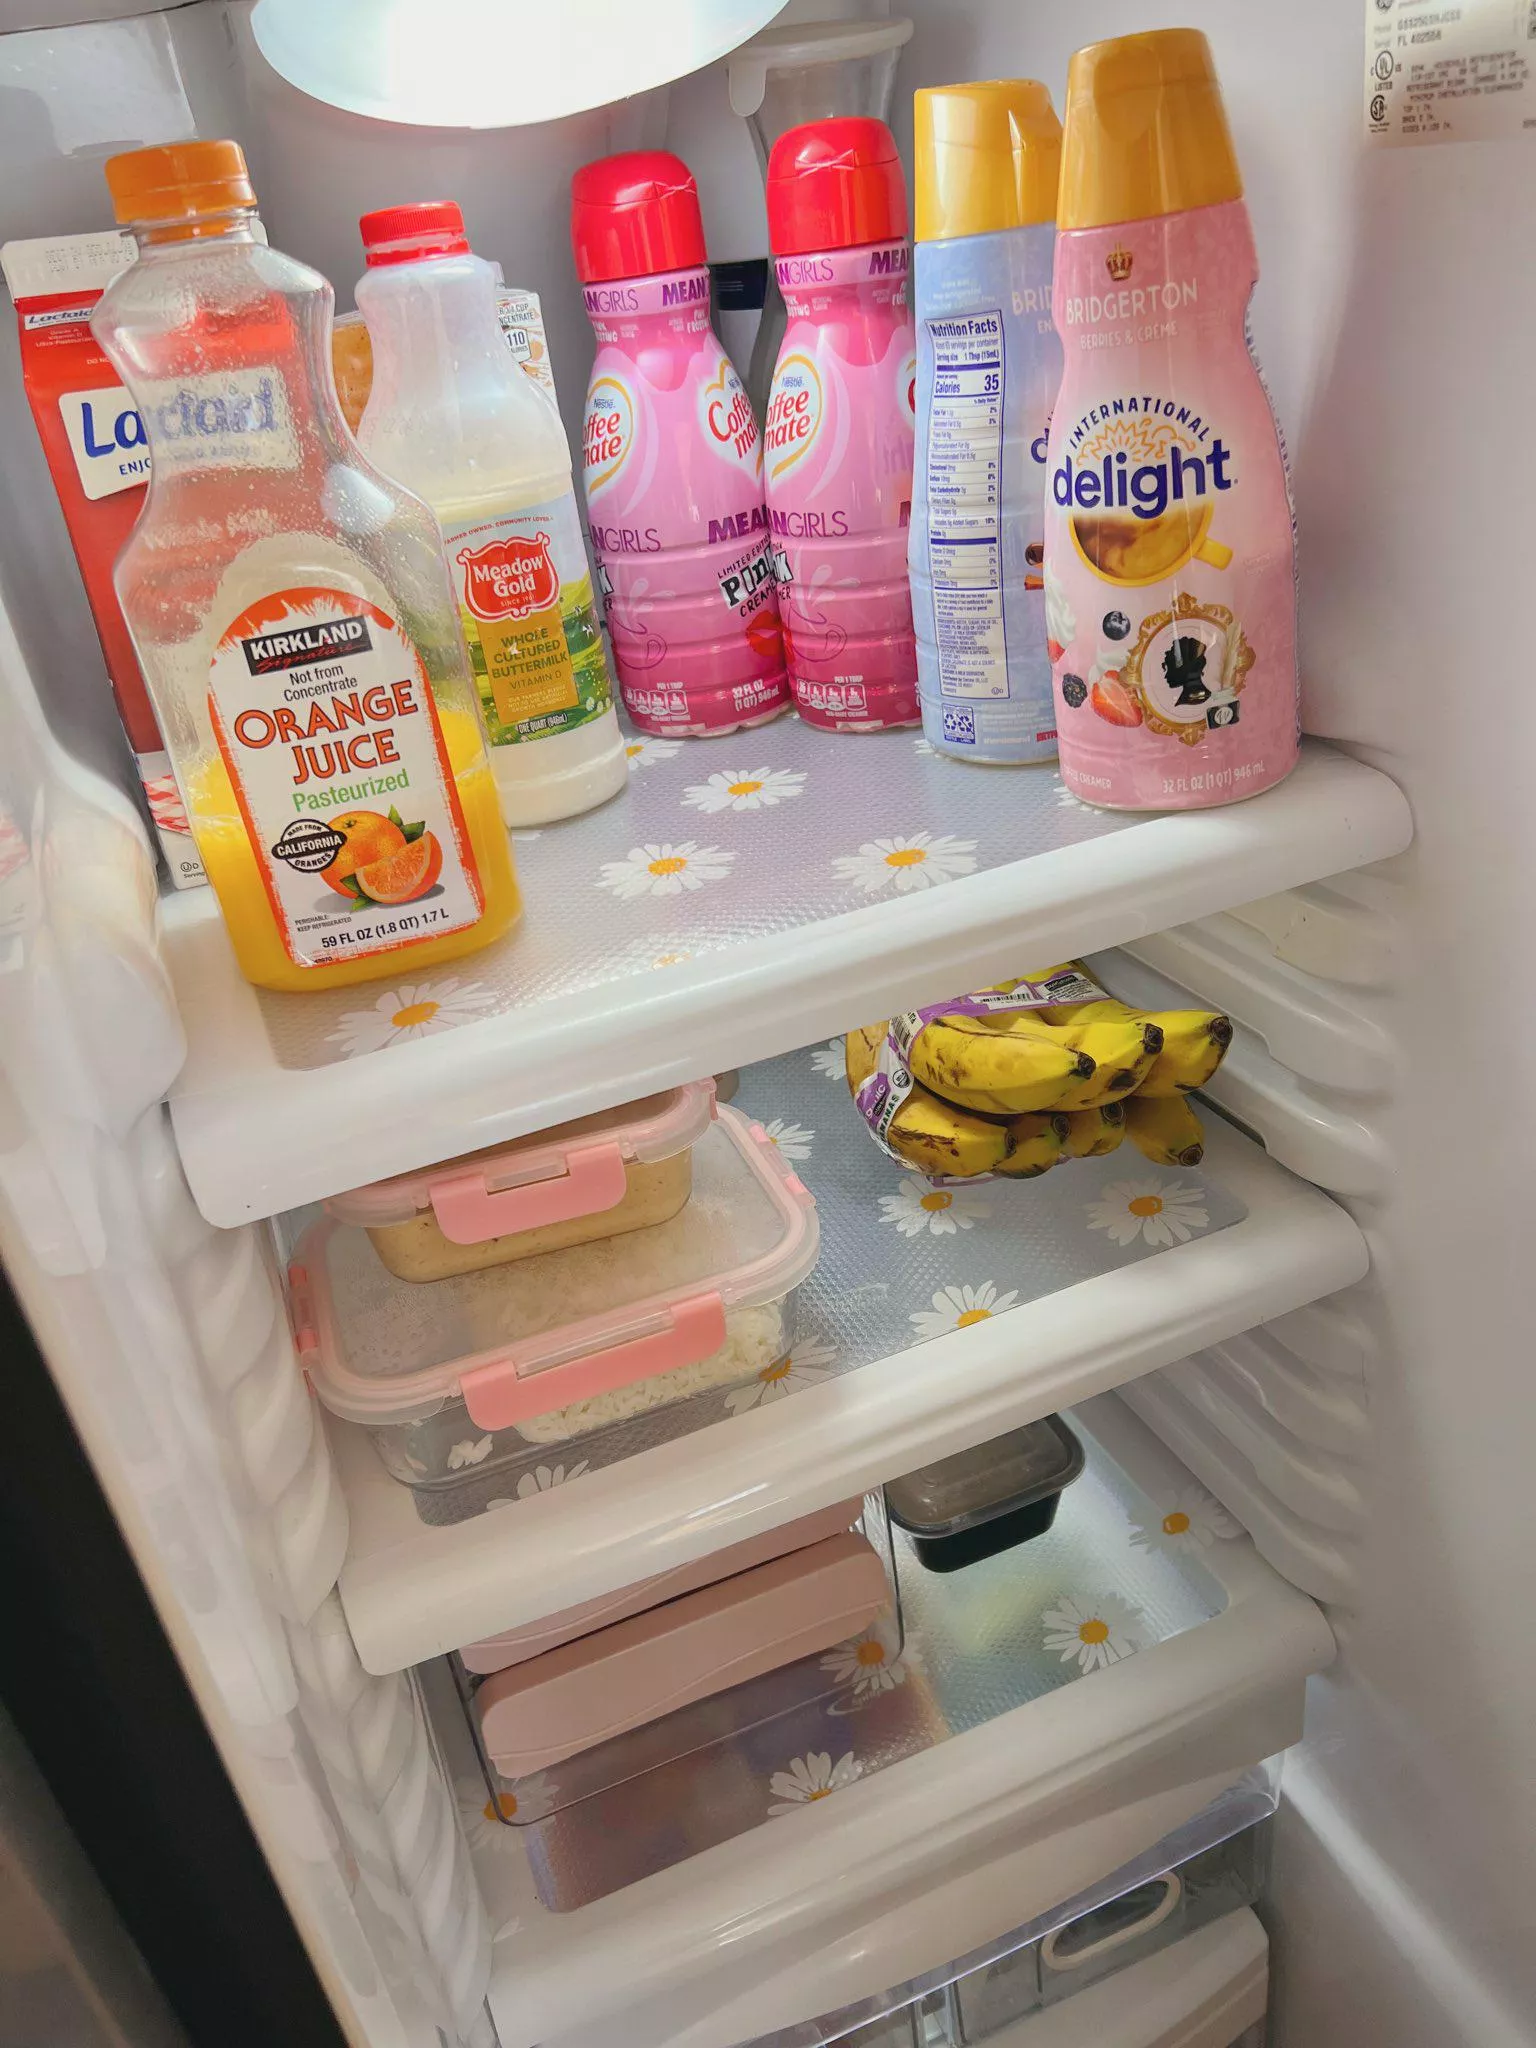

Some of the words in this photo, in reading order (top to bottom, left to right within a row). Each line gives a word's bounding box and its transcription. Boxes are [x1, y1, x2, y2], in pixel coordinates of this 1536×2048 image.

[1067, 278, 1198, 326] BRIDGERTON
[507, 331, 526, 347] 110
[930, 323, 968, 338] Nutrition
[968, 318, 998, 335] Facts
[1081, 331, 1121, 350] BERRIES
[935, 381, 960, 394] Calories
[984, 373, 999, 391] 35
[766, 390, 810, 427] offee
[1069, 397, 1210, 449] INTERNATIONAL
[1053, 438, 1232, 520] delight
[473, 555, 544, 583] Meadow
[718, 553, 751, 579] LIMITED
[493, 573, 536, 597] Gold
[250, 622, 363, 661] KIRKLAND
[500, 628, 549, 647] WHOLE
[492, 651, 568, 678] BUTTERMILK
[494, 640, 560, 664] CULTURED
[290, 672, 311, 686] Not
[315, 665, 344, 680] from
[510, 674, 552, 690] VITAMIN
[554, 670, 562, 680] D
[284, 677, 358, 702] Concentrate
[234, 679, 418, 749] ORANGE
[291, 728, 401, 786] JUICE
[292, 768, 410, 813] Pasteurized
[1163, 780, 1175, 793] 32
[1177, 778, 1189, 792] FL
[1191, 776, 1203, 790] OZ
[1216, 768, 1232, 788] QT)
[287, 825, 303, 837] MADE
[304, 824, 322, 832] FROM
[277, 834, 342, 857] CALIFORNIA
[294, 852, 332, 868] ORANGES
[312, 917, 352, 930] REFRIGERATED
[321, 935, 337, 949] 59
[339, 932, 355, 945] FL
[357, 928, 374, 942] OZ
[375, 921, 397, 939] (1.8
[400, 916, 420, 931] QT)
[421, 911, 437, 924] 1.7
[440, 908, 450, 919] L
